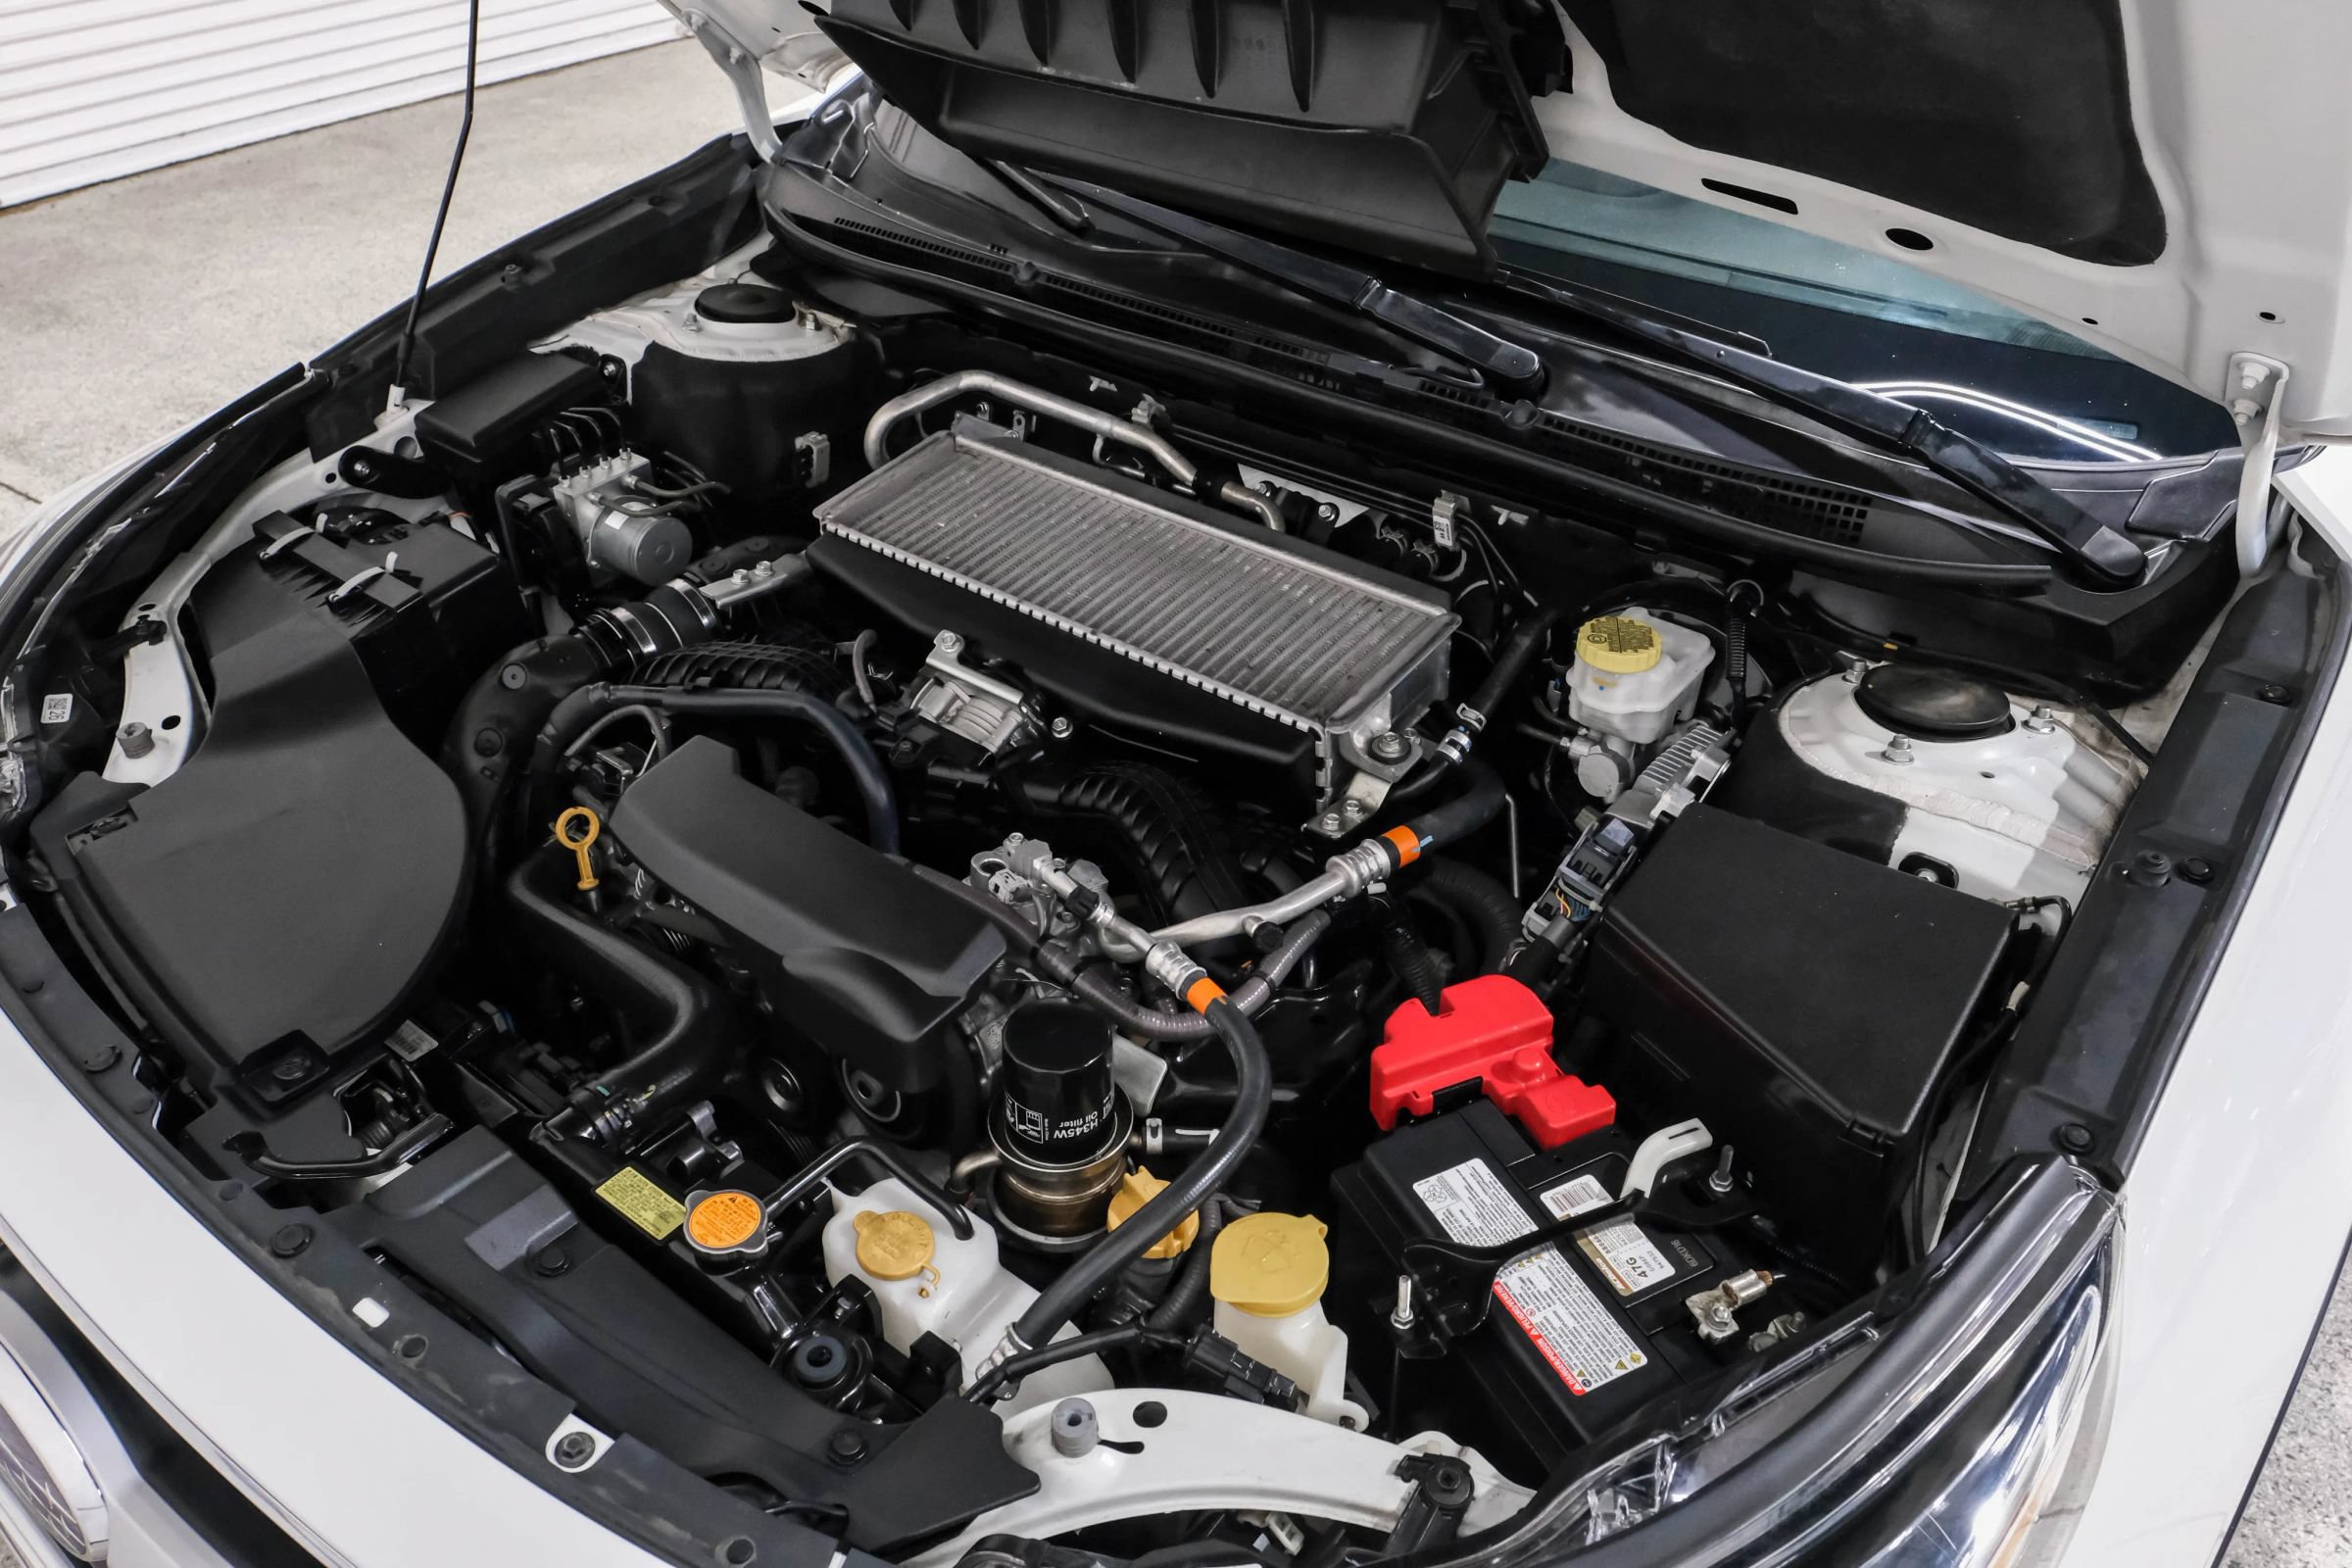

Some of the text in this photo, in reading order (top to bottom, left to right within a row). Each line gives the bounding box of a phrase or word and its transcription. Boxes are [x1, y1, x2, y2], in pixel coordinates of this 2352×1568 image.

[48, 710, 66, 720] 26
[1054, 1118, 1099, 1139] H345W
[1058, 1110, 1098, 1128] Oil filter
[1626, 1257, 1648, 1278] 47G
[1537, 1338, 1576, 1385] DANGER/POISON
